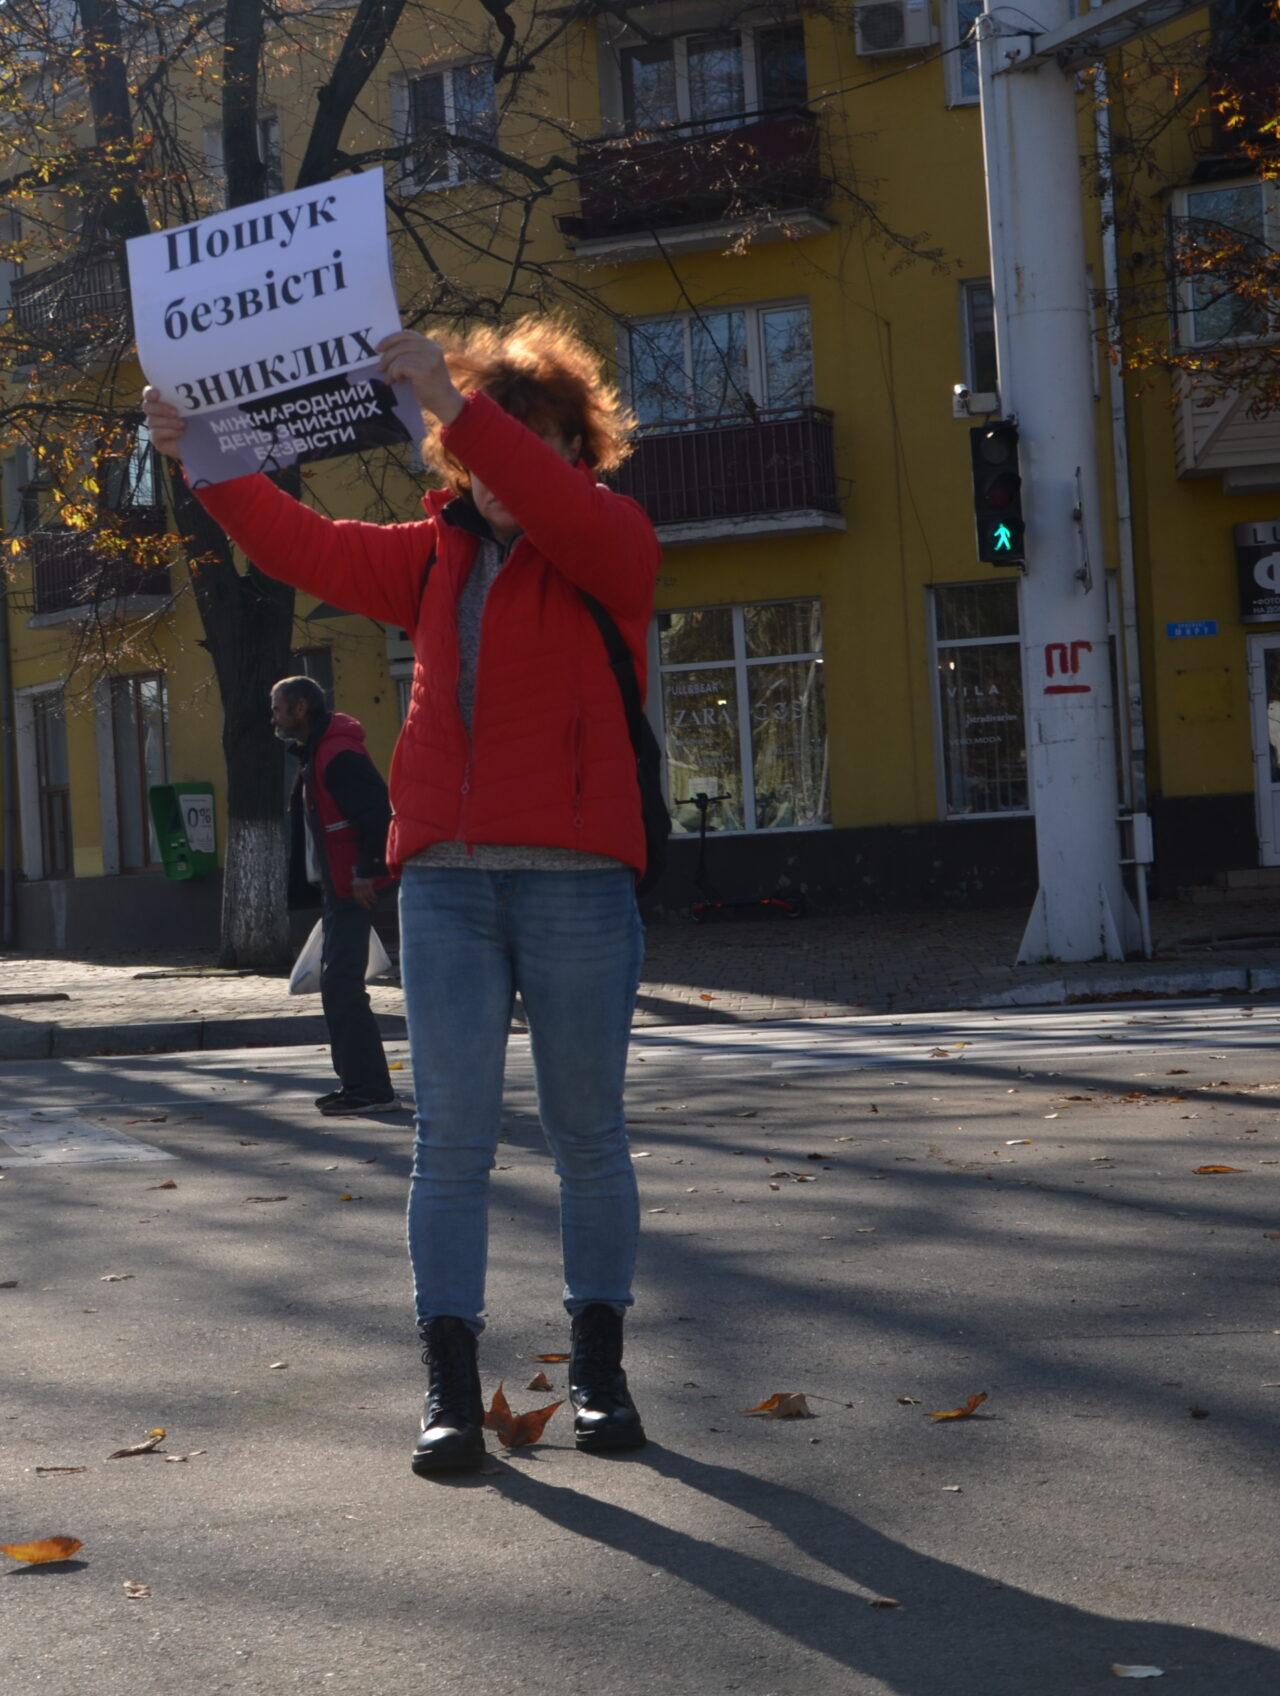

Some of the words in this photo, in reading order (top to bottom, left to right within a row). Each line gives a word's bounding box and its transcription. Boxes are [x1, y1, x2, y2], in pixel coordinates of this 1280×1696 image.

[165, 195, 338, 273] Пошук
[164, 249, 348, 340] безвісті
[175, 327, 380, 411] зниклих
[209, 381, 375, 434] МІЖНАРОДНИЙ
[219, 426, 274, 454] ДЕНЬ
[277, 399, 383, 441] ЗНИКЛИХ
[253, 427, 357, 461] БЕЗВІСТИ
[673, 707, 733, 727] ZARA
[946, 684, 1000, 698] VILA
